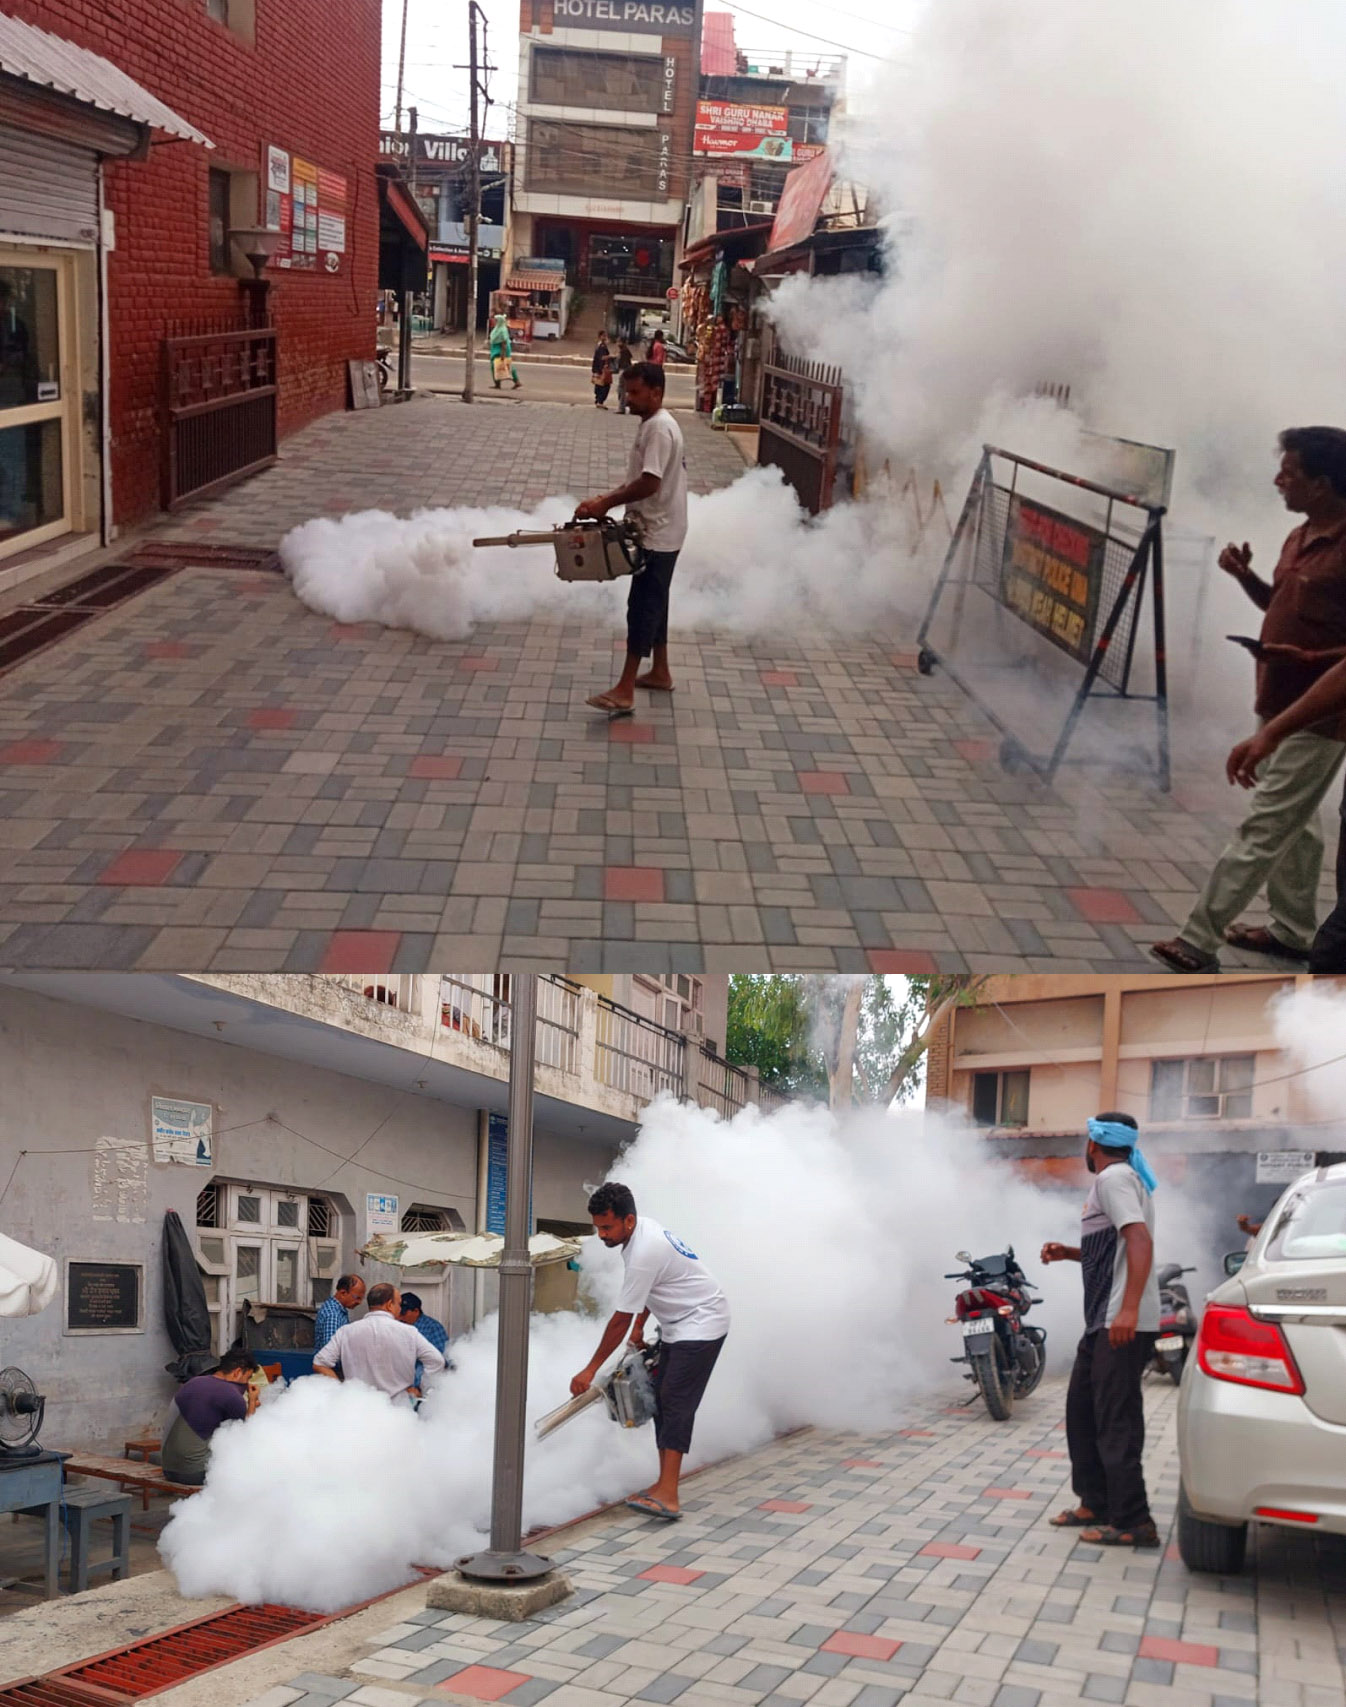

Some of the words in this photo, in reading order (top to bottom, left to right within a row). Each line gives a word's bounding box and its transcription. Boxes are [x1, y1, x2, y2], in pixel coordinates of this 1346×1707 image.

[554, 0, 620, 20] HOTEL
[624, 2, 694, 25] PARAS
[663, 57, 675, 112] HOTEL
[700, 105, 722, 117] SHRI
[724, 107, 751, 119] GURU
[752, 110, 785, 121] NANAK
[747, 118, 773, 128] DHABA
[658, 134, 670, 190] PARAS
